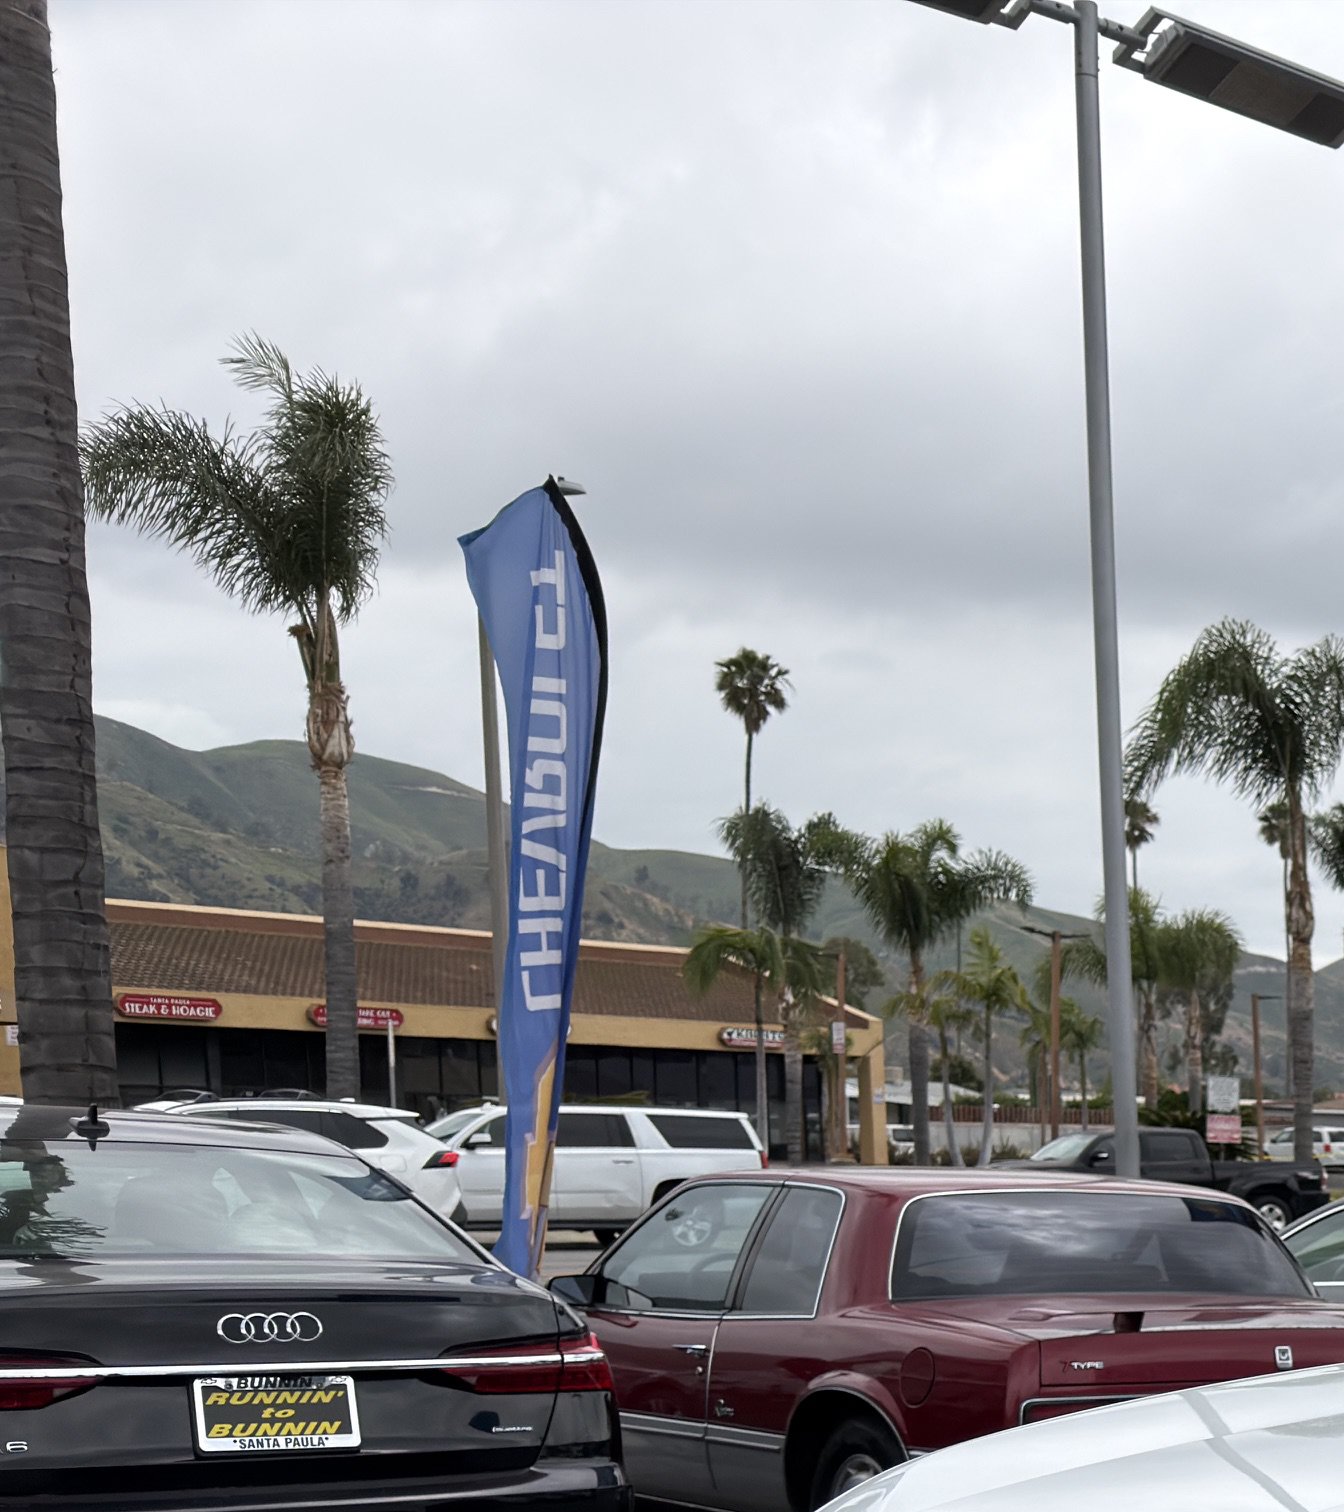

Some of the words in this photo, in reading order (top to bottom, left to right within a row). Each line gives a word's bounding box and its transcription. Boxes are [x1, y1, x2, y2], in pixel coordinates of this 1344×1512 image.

[124, 1002, 158, 1014] STEAK
[160, 1004, 170, 1015] &
[171, 1006, 217, 1018] HOAGIE
[1071, 1361, 1104, 1370] TYPE
[236, 1376, 312, 1389] BUNNIN
[205, 1390, 346, 1406] RUNNIN'
[261, 1407, 296, 1419] to
[207, 1420, 342, 1438] BUNNIN
[238, 1437, 281, 1450] SANTA
[284, 1436, 327, 1449] PAULA
